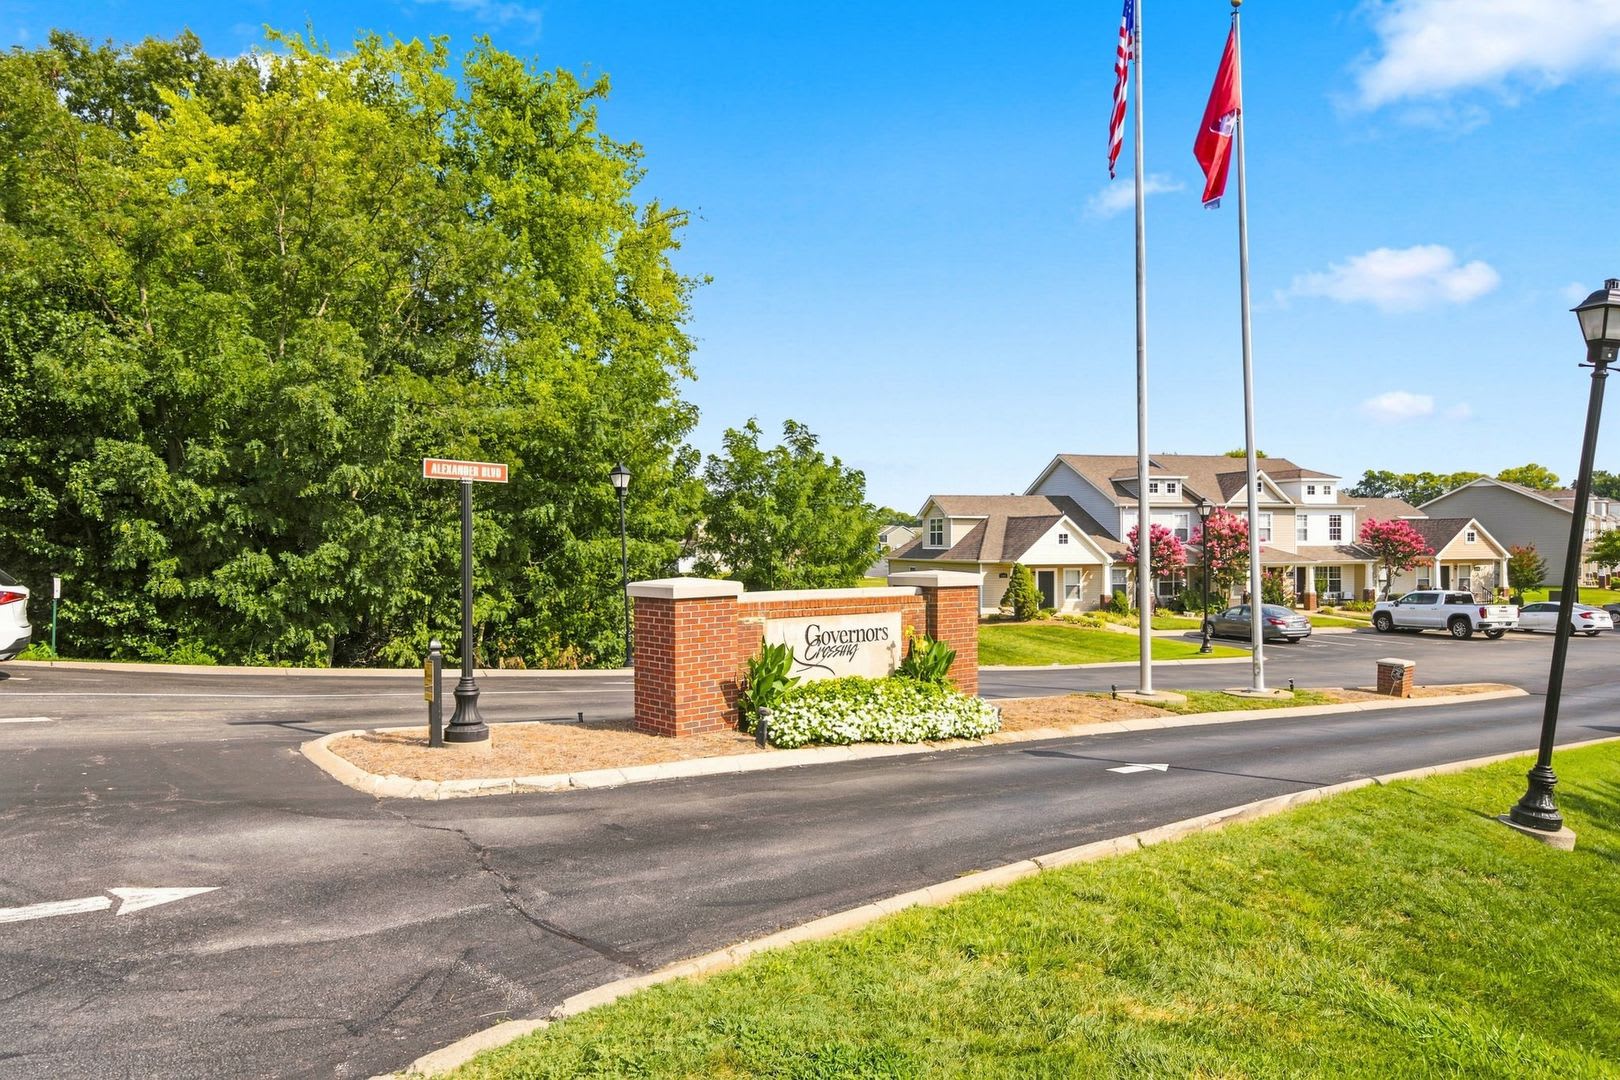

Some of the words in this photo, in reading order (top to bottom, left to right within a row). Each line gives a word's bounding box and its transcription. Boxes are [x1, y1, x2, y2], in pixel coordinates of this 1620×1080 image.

[431, 462, 479, 476] ALEXANDER
[481, 466, 502, 478] BLVD
[805, 624, 889, 647] Governors
[804, 638, 859, 662] Crossing
